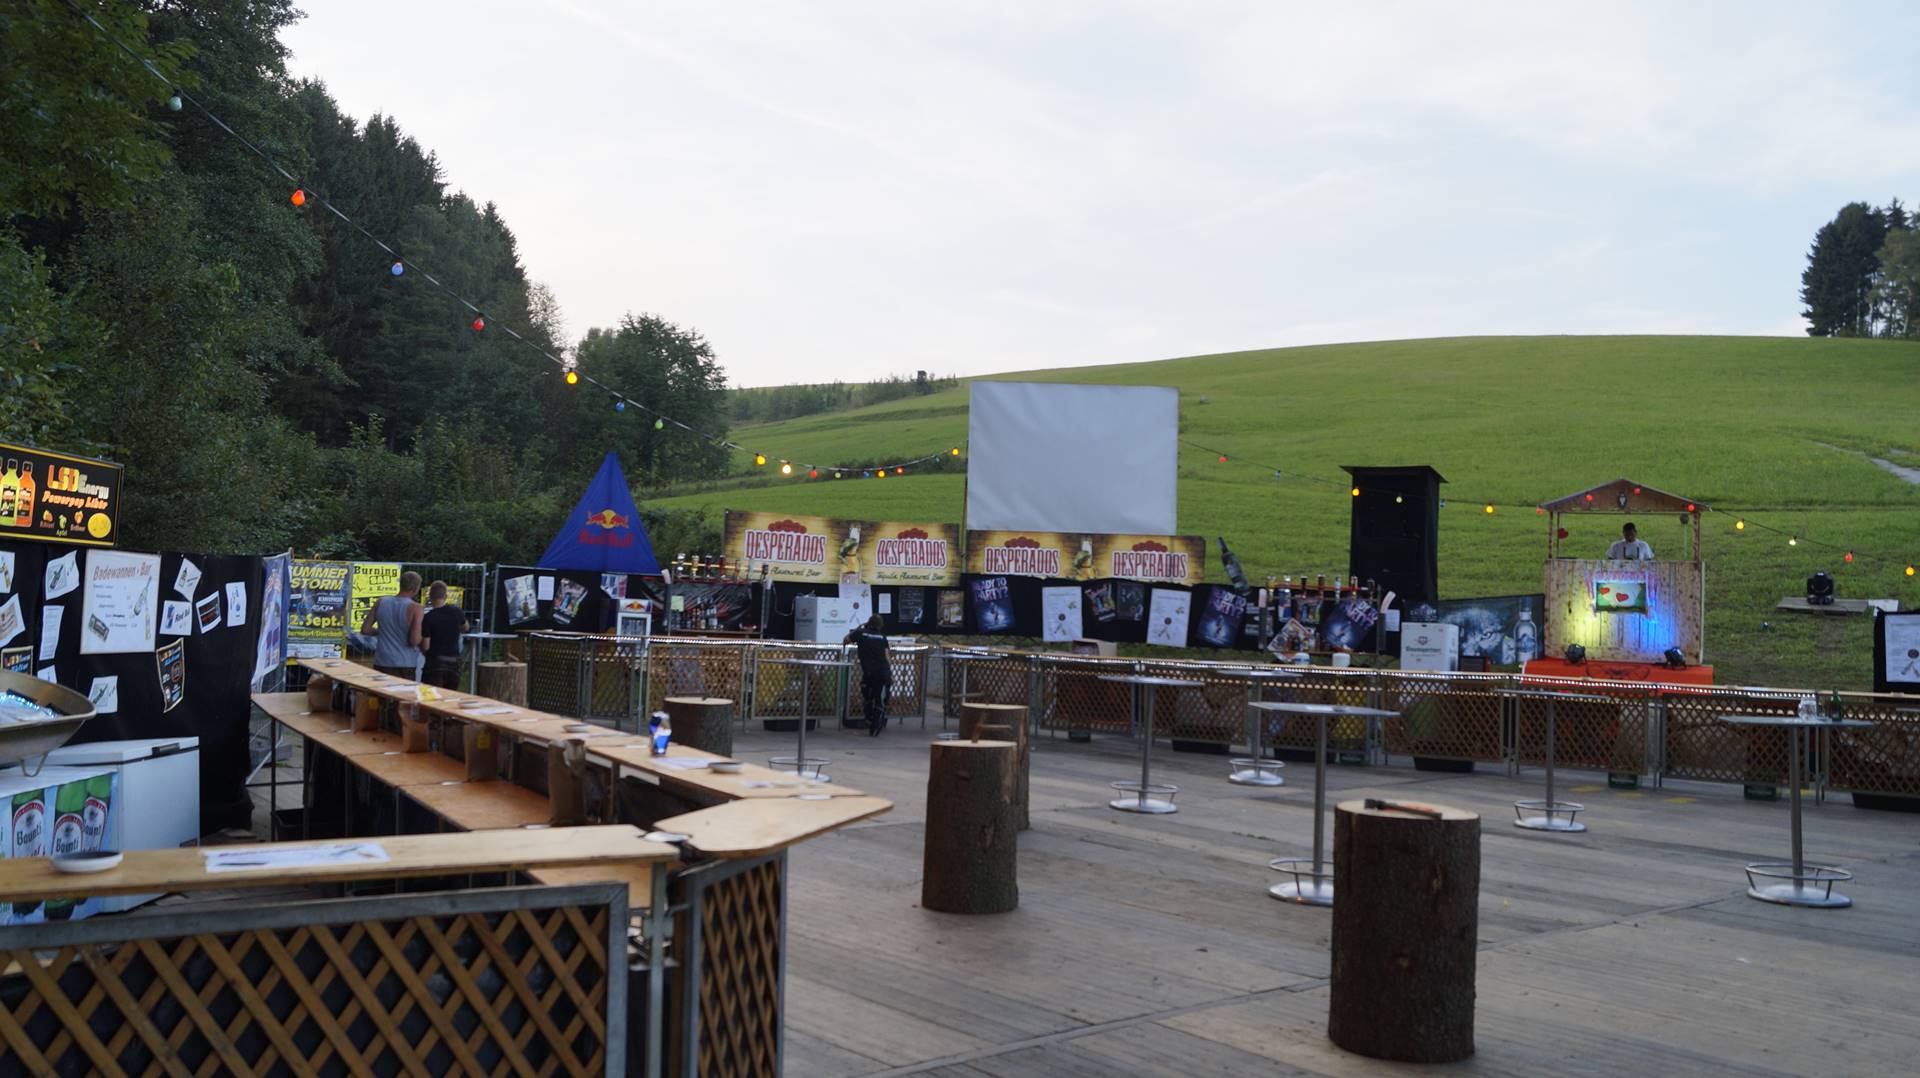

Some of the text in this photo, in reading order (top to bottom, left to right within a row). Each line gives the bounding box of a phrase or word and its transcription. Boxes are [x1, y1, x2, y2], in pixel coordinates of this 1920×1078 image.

[48, 465, 80, 492] LSD
[746, 531, 825, 562] DESPERADOS
[877, 539, 946, 567] DESPERADOS
[354, 565, 398, 577] Burning
[986, 548, 1059, 574] DESPERADOS
[1113, 552, 1187, 578] DESPERADOS
[291, 577, 345, 590] STORM
